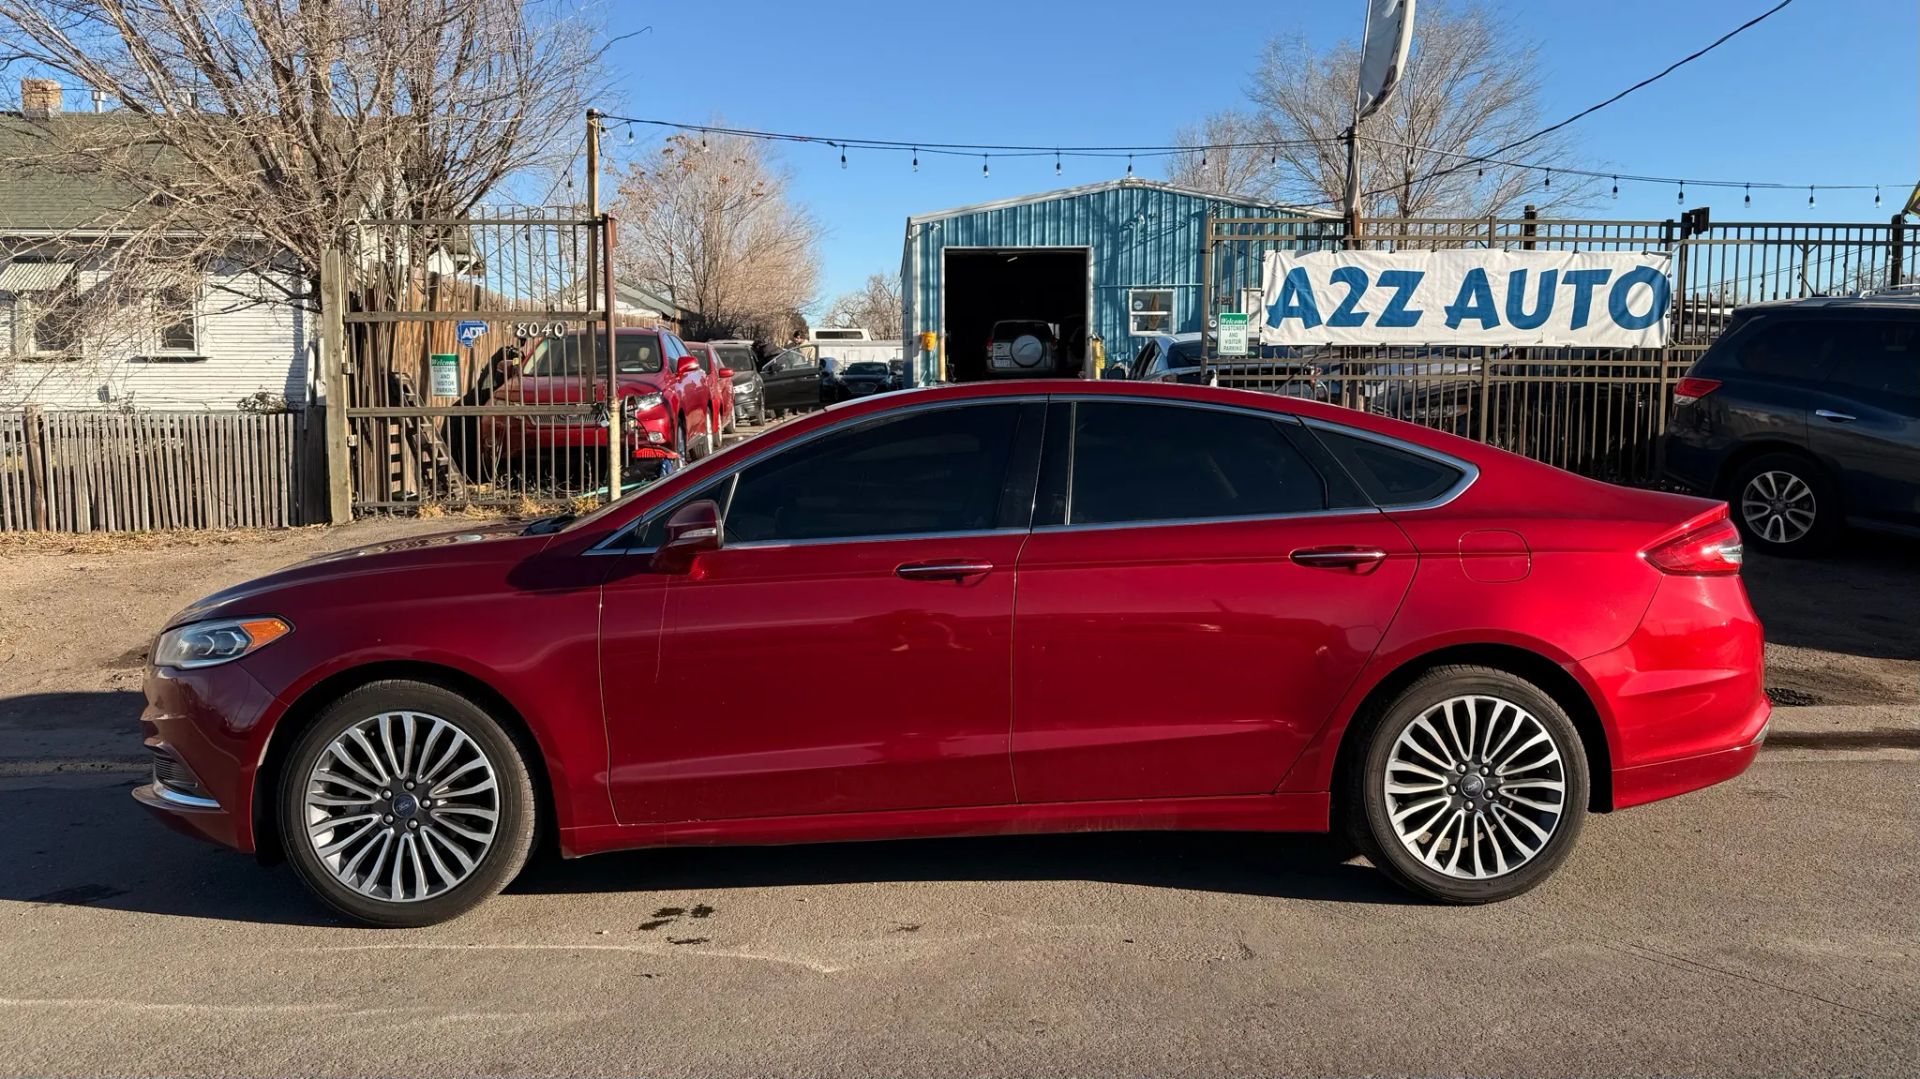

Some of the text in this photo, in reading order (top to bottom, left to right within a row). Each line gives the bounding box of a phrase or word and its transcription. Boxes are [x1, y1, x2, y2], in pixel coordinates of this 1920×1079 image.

[1266, 265, 1671, 331] A2Z AUTO
[1221, 317, 1247, 325] Welcome
[462, 326, 485, 339] ADT
[516, 322, 564, 337] 8040
